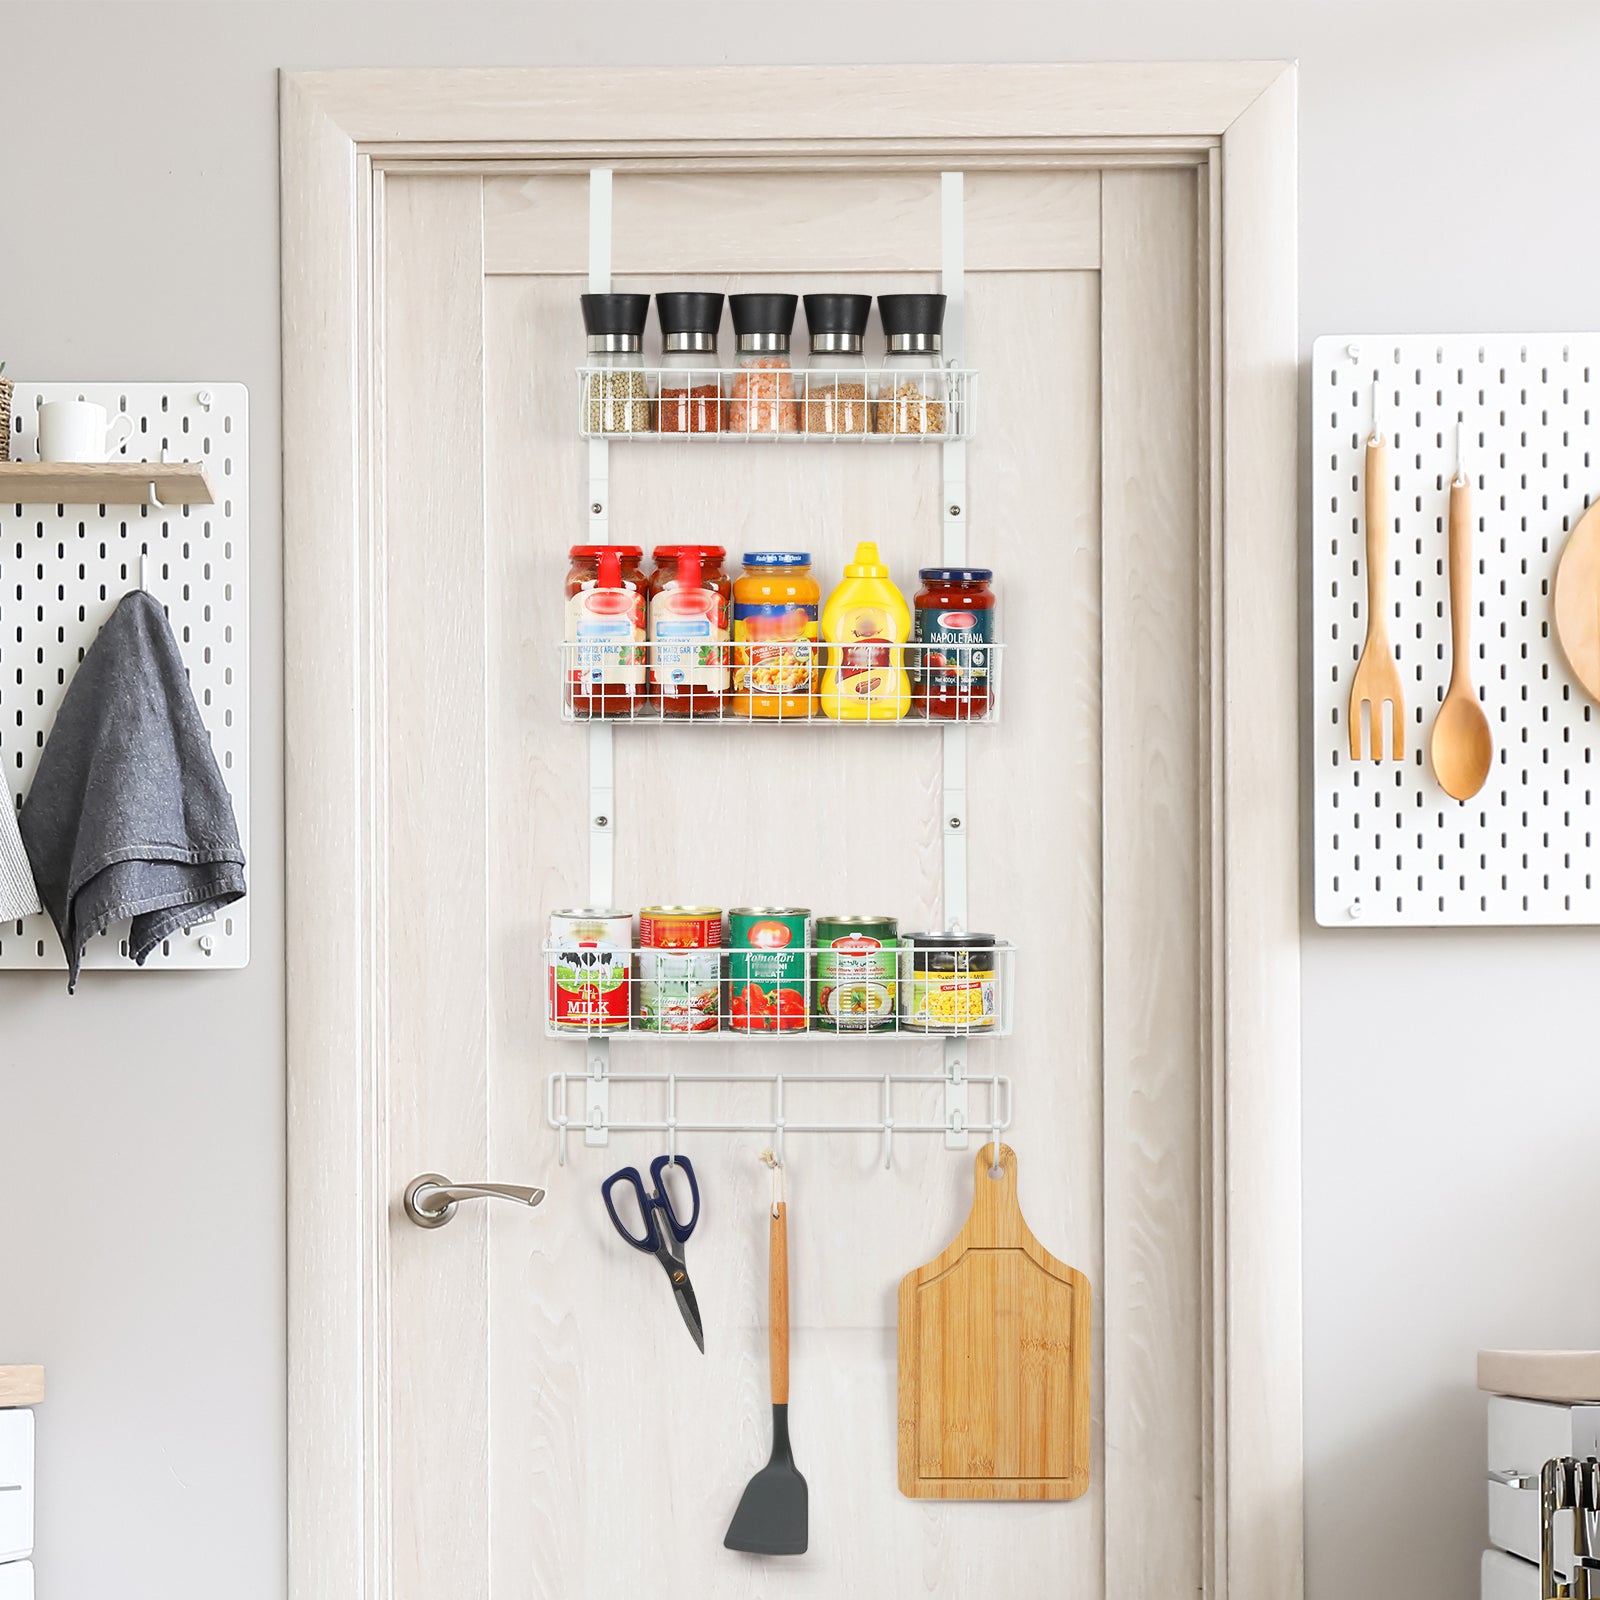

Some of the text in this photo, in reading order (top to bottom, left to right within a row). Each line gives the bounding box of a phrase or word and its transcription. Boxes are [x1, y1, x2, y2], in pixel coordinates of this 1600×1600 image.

[930, 632, 983, 644] NAPOLETANA
[679, 645, 699, 654] GARIC
[745, 952, 795, 963] Pomodori
[567, 1000, 610, 1014] MILK
